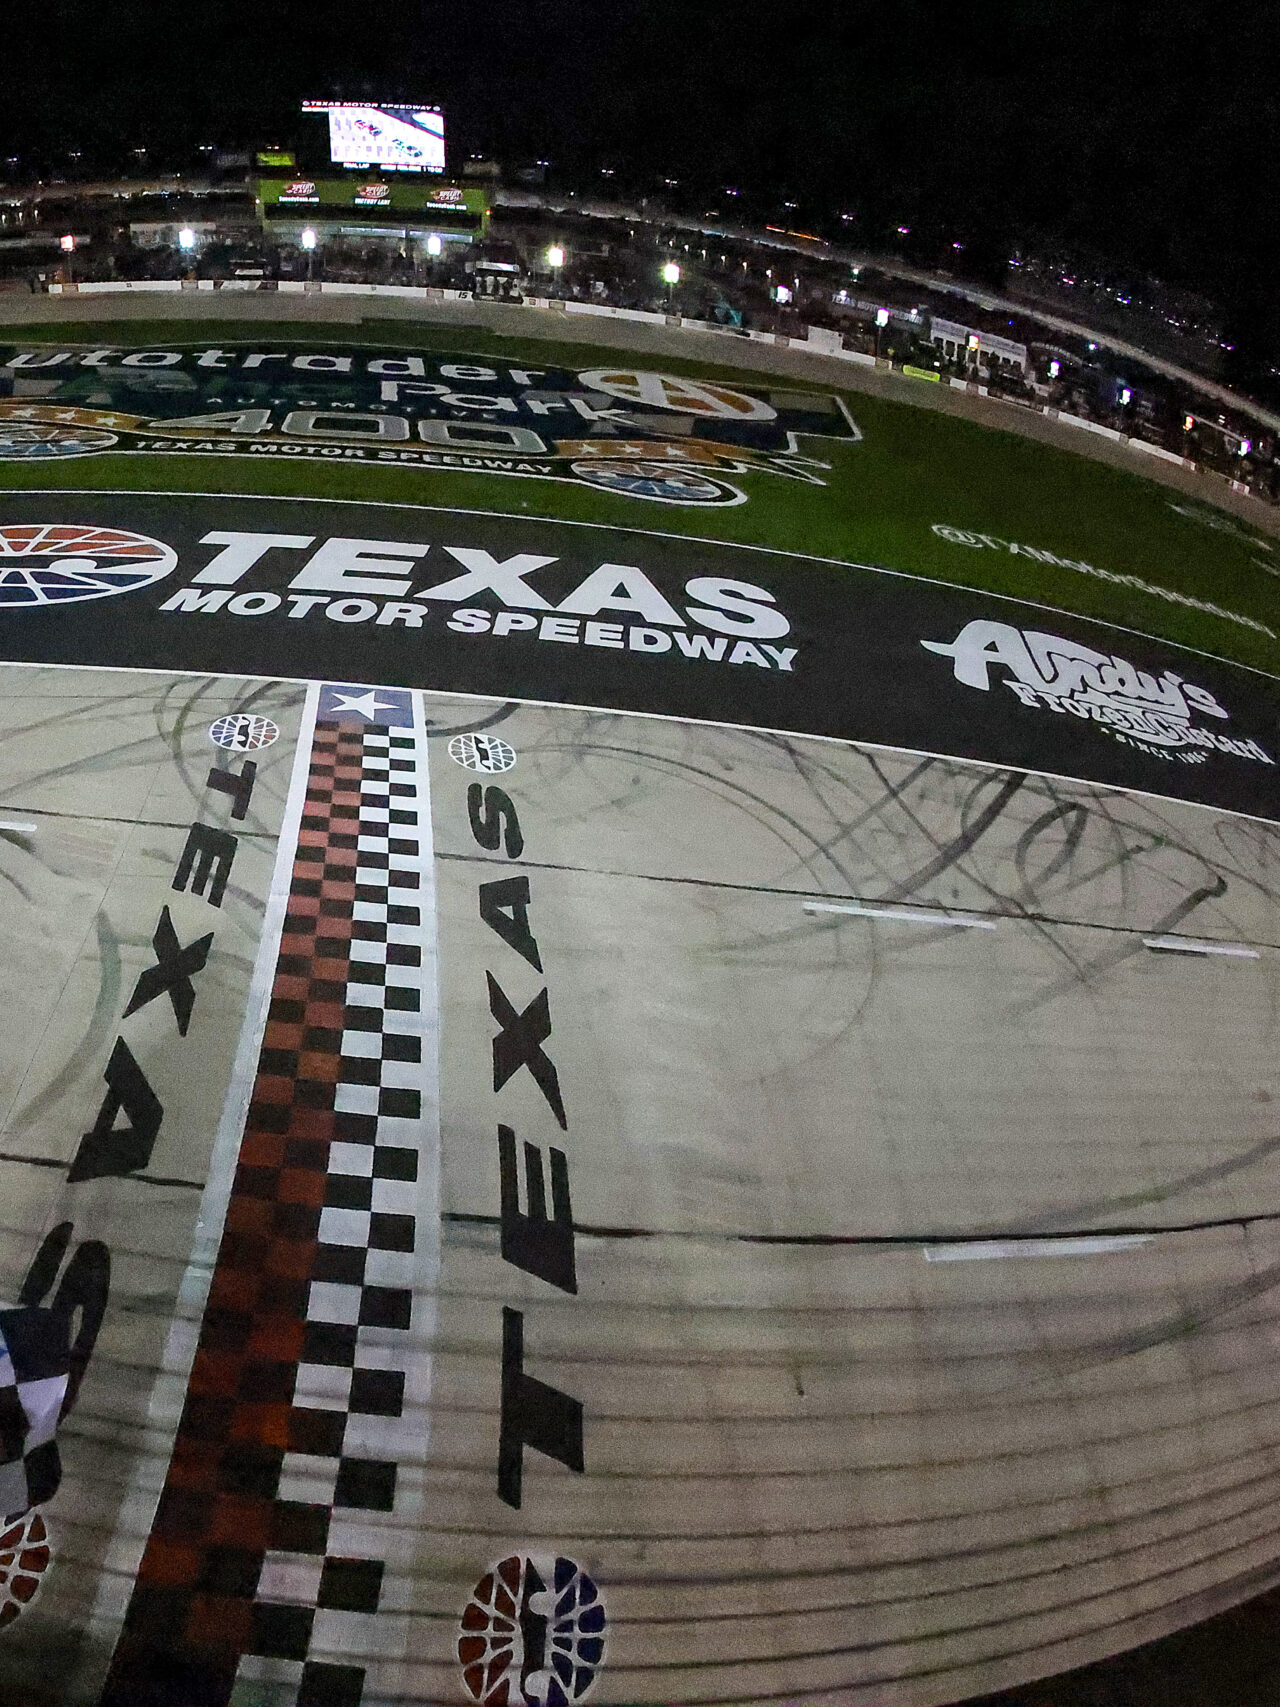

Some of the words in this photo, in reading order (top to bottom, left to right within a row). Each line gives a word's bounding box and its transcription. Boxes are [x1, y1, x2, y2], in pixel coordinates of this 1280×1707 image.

[381, 103, 432, 111] SPEEDWAY
[148, 408, 549, 454] 400
[207, 397, 498, 419] AUTOMOTIVE
[381, 379, 642, 426] Park
[136, 440, 236, 454] TEXAS
[250, 443, 365, 460] MOTOR
[376, 450, 553, 475] SPEEDWAY
[192, 530, 791, 640] TEXAS
[158, 588, 428, 628] MOTOR
[446, 608, 799, 672] SPEEDWAY
[920, 619, 1229, 719] Andy's
[1002, 679, 1160, 737] Frozen
[1144, 709, 1276, 765] Custard
[1115, 733, 1174, 761] SINCE
[19, 760, 258, 1426] TEXAS
[467, 782, 585, 1510] TEXAS
